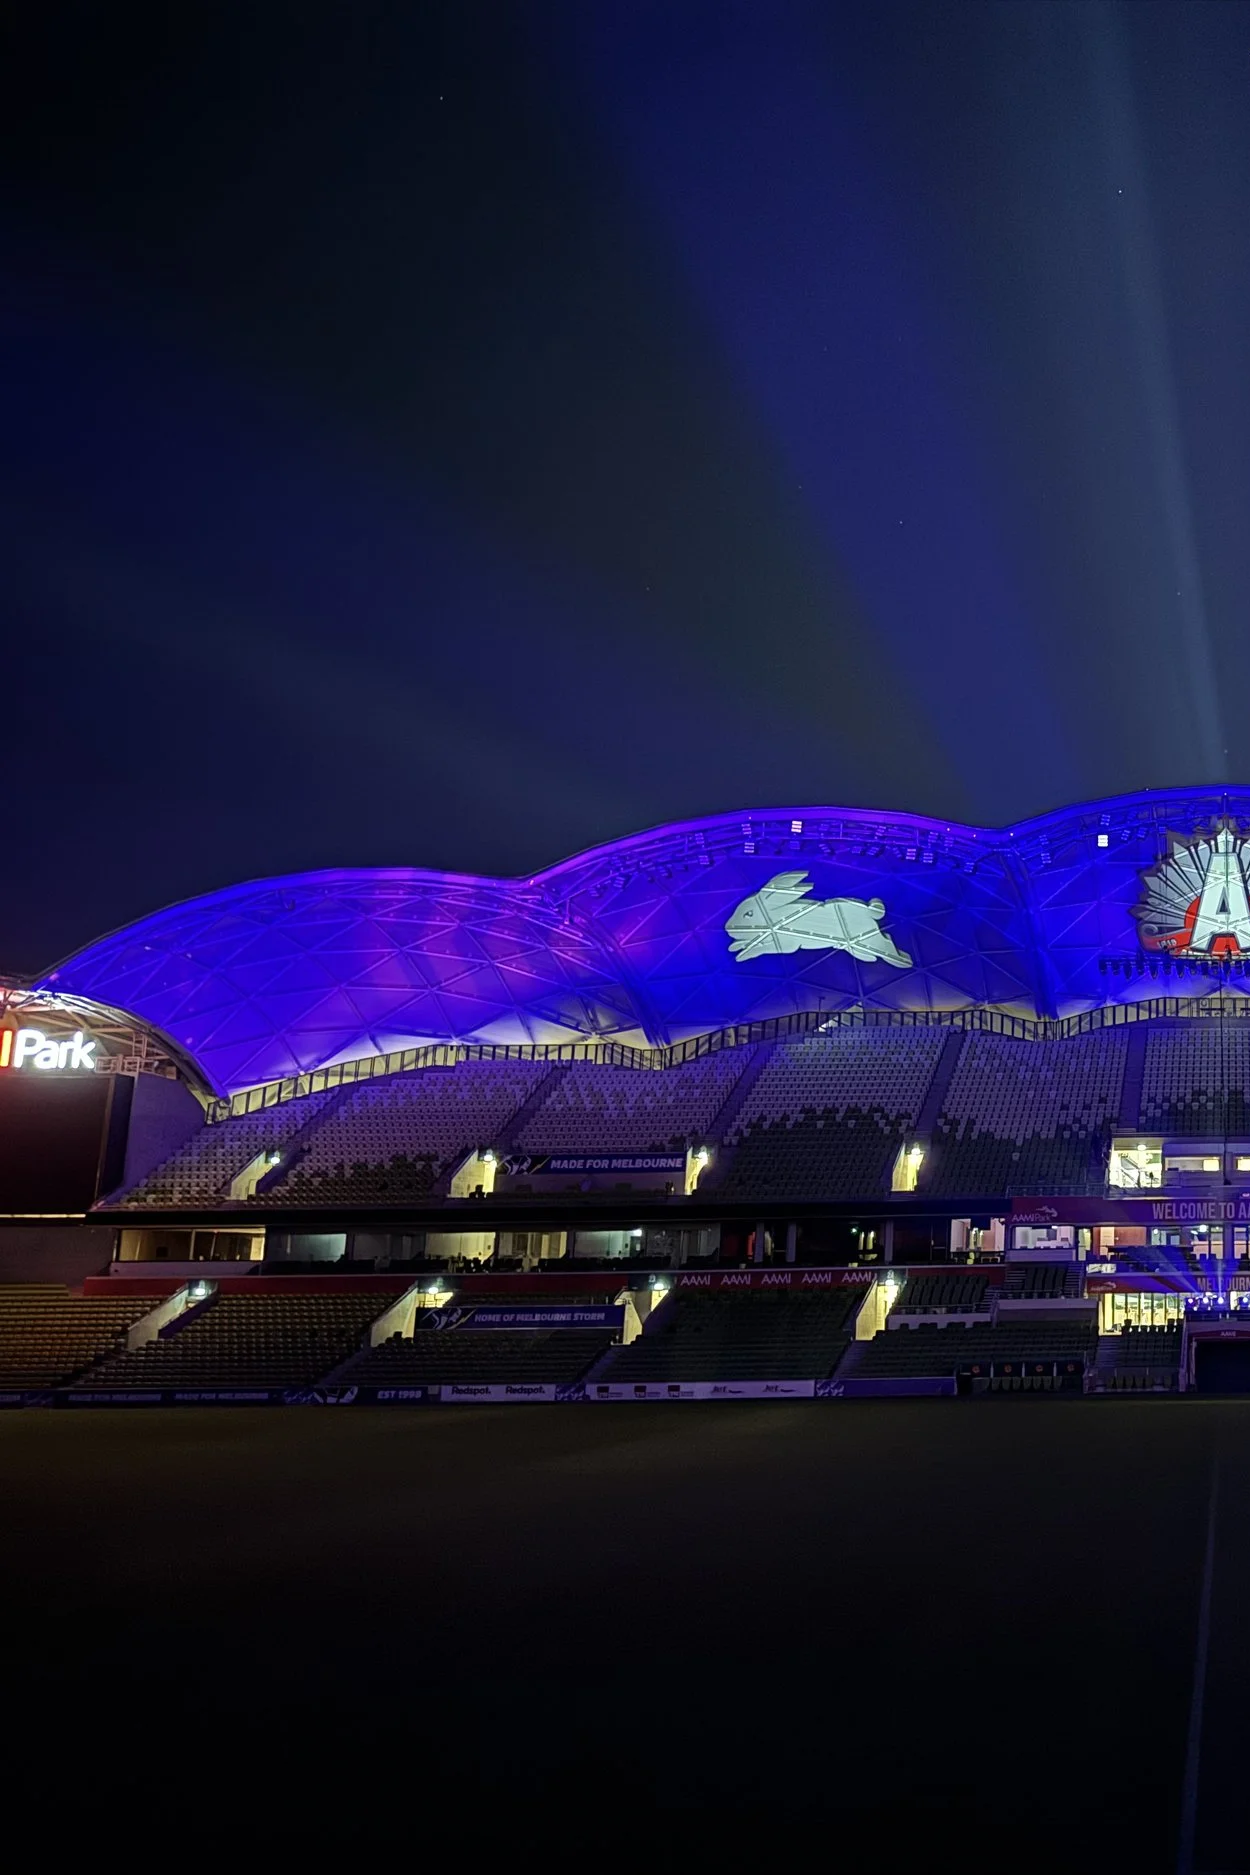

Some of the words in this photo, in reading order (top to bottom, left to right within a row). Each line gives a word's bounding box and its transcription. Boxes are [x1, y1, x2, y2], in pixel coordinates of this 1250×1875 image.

[13, 1028, 96, 1069] Park
[551, 1159, 584, 1169] MADE
[586, 1158, 609, 1168] FOR
[611, 1157, 684, 1168] MELBOURNE
[1152, 1201, 1216, 1219] WELCOME
[1218, 1201, 1235, 1219] TO
[680, 1275, 711, 1286] AAMI
[720, 1274, 751, 1285] AAMI
[761, 1273, 791, 1284] AAMI
[801, 1272, 832, 1283] AAMI
[841, 1271, 872, 1282] AAMI
[474, 1313, 500, 1322] HOME
[503, 1313, 515, 1322] OF
[516, 1312, 572, 1321] MELBOURNE
[573, 1312, 605, 1321] STORM
[377, 1390, 395, 1399] EST
